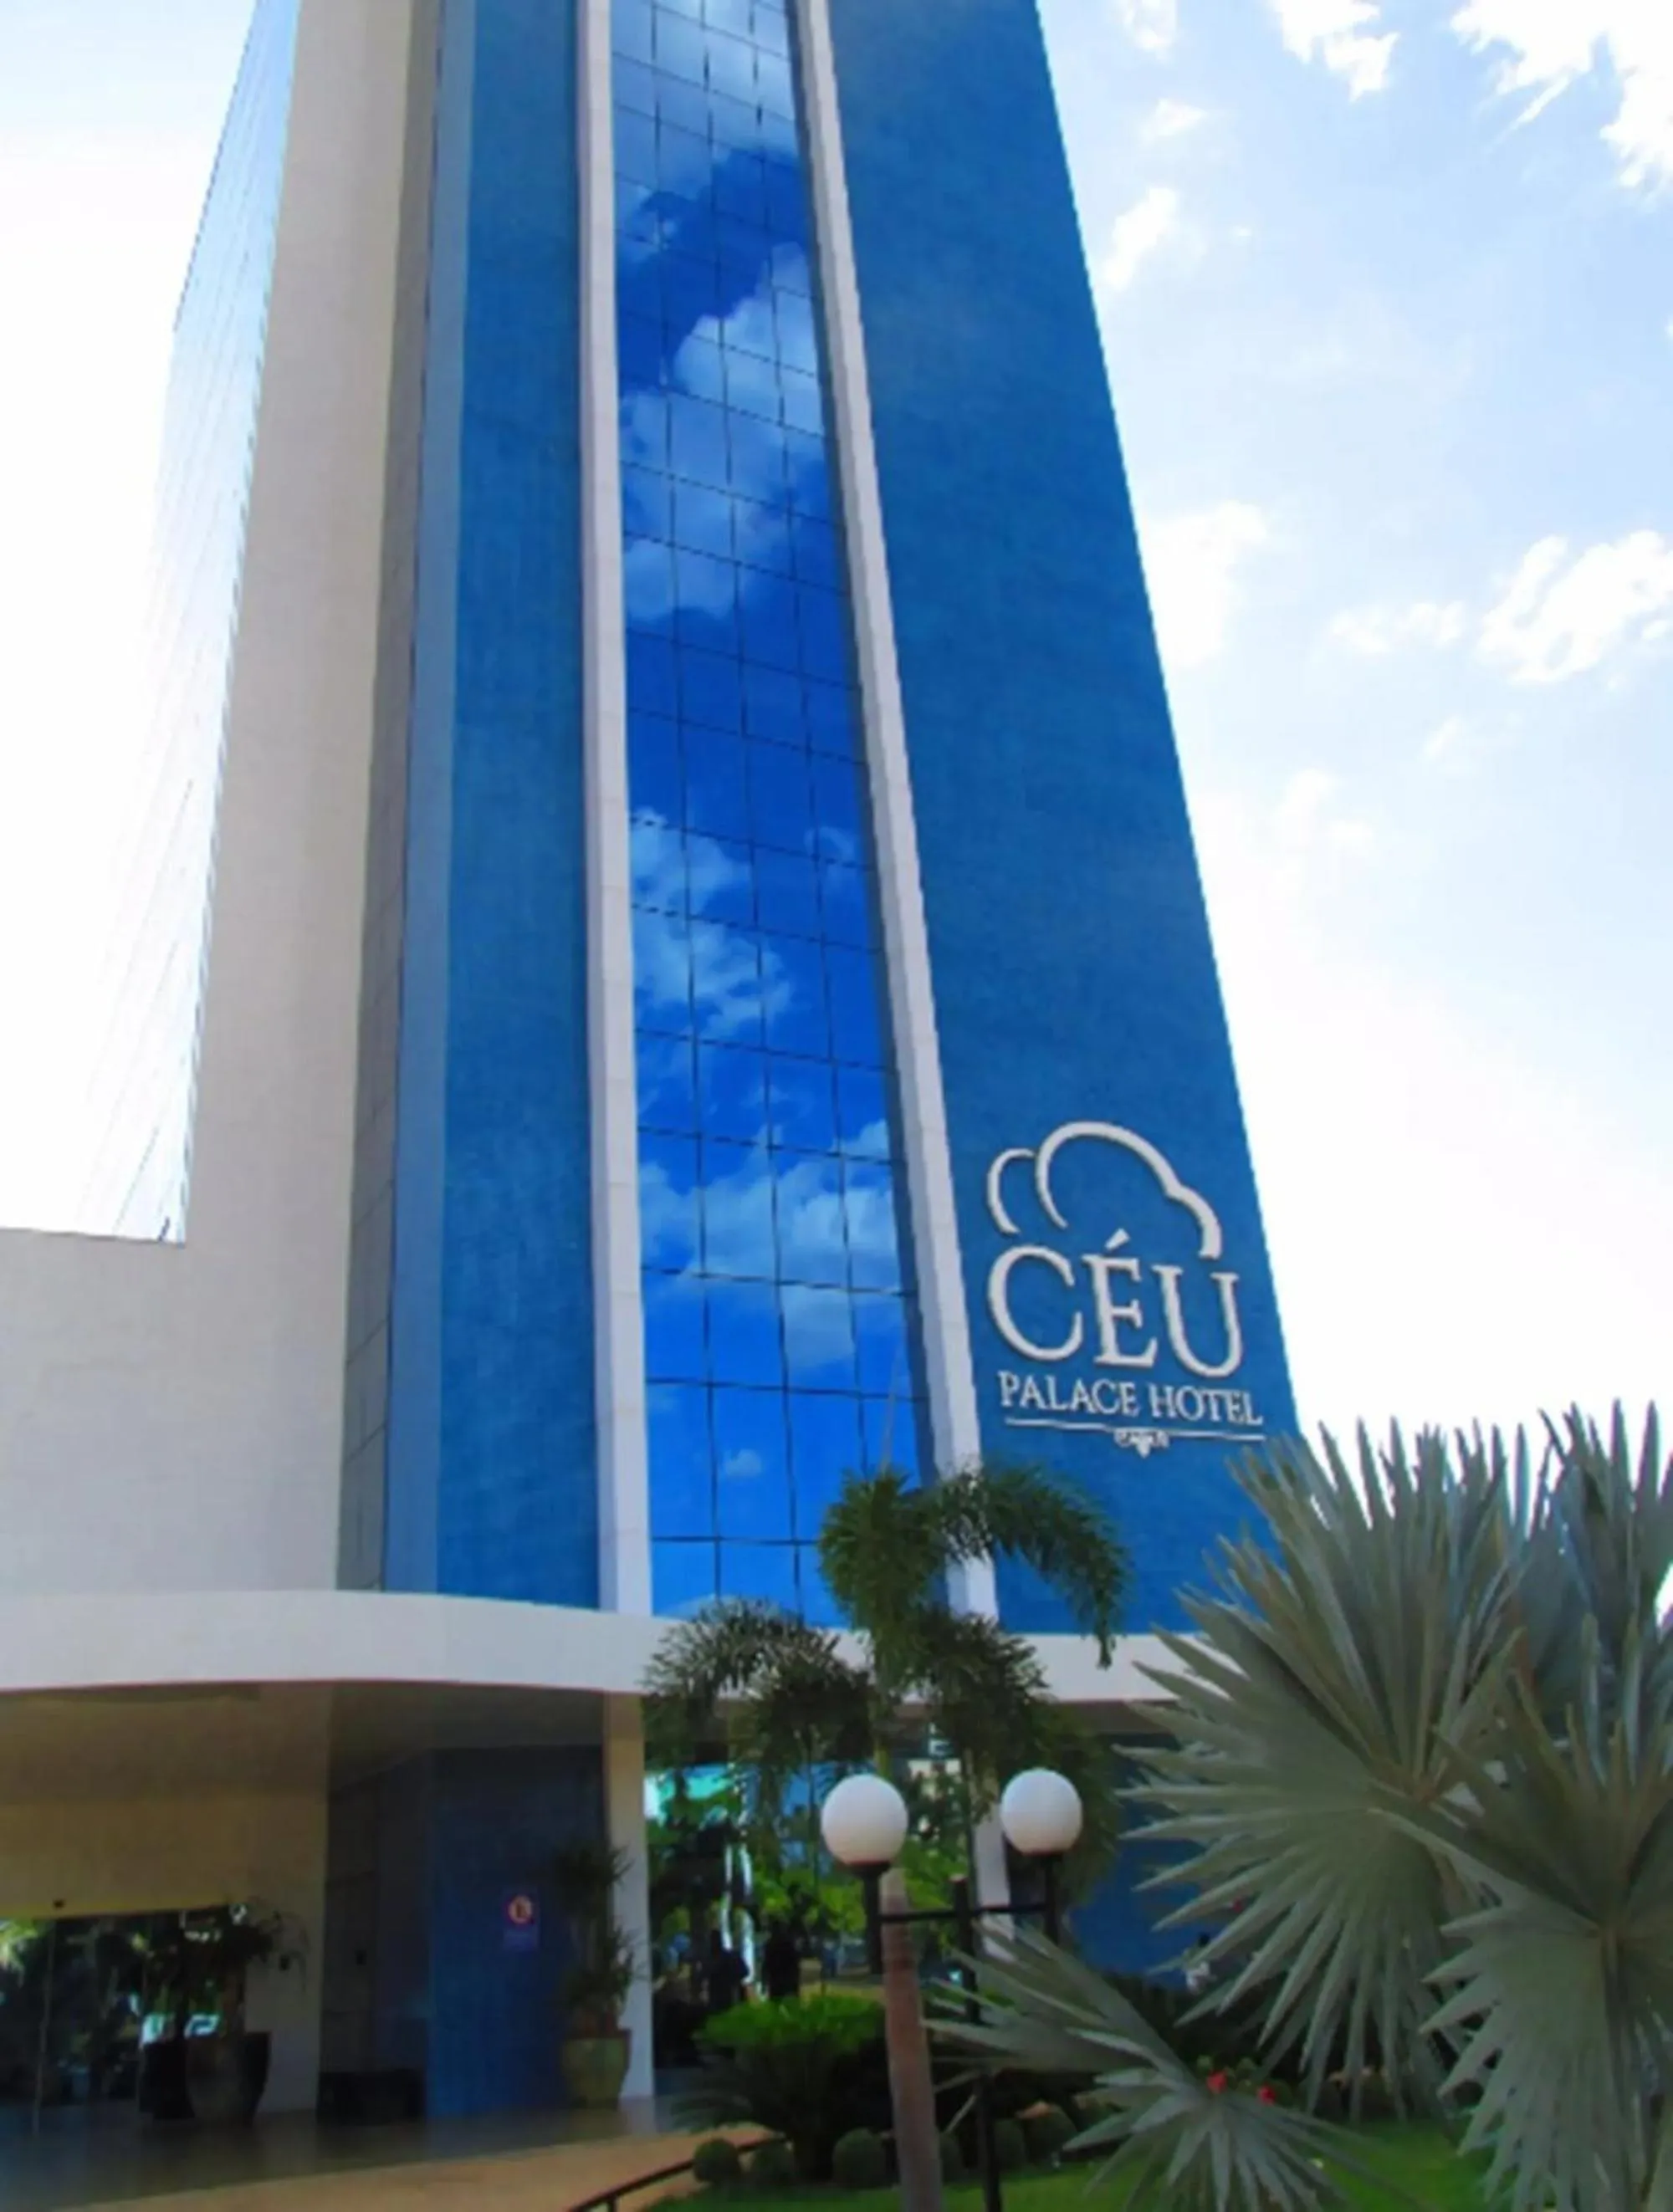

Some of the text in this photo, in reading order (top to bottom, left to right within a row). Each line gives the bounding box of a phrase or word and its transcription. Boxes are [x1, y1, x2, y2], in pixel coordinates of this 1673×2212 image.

[988, 1228, 1243, 1377] CÉU
[998, 1371, 1264, 1425] PALACE HOTEL
